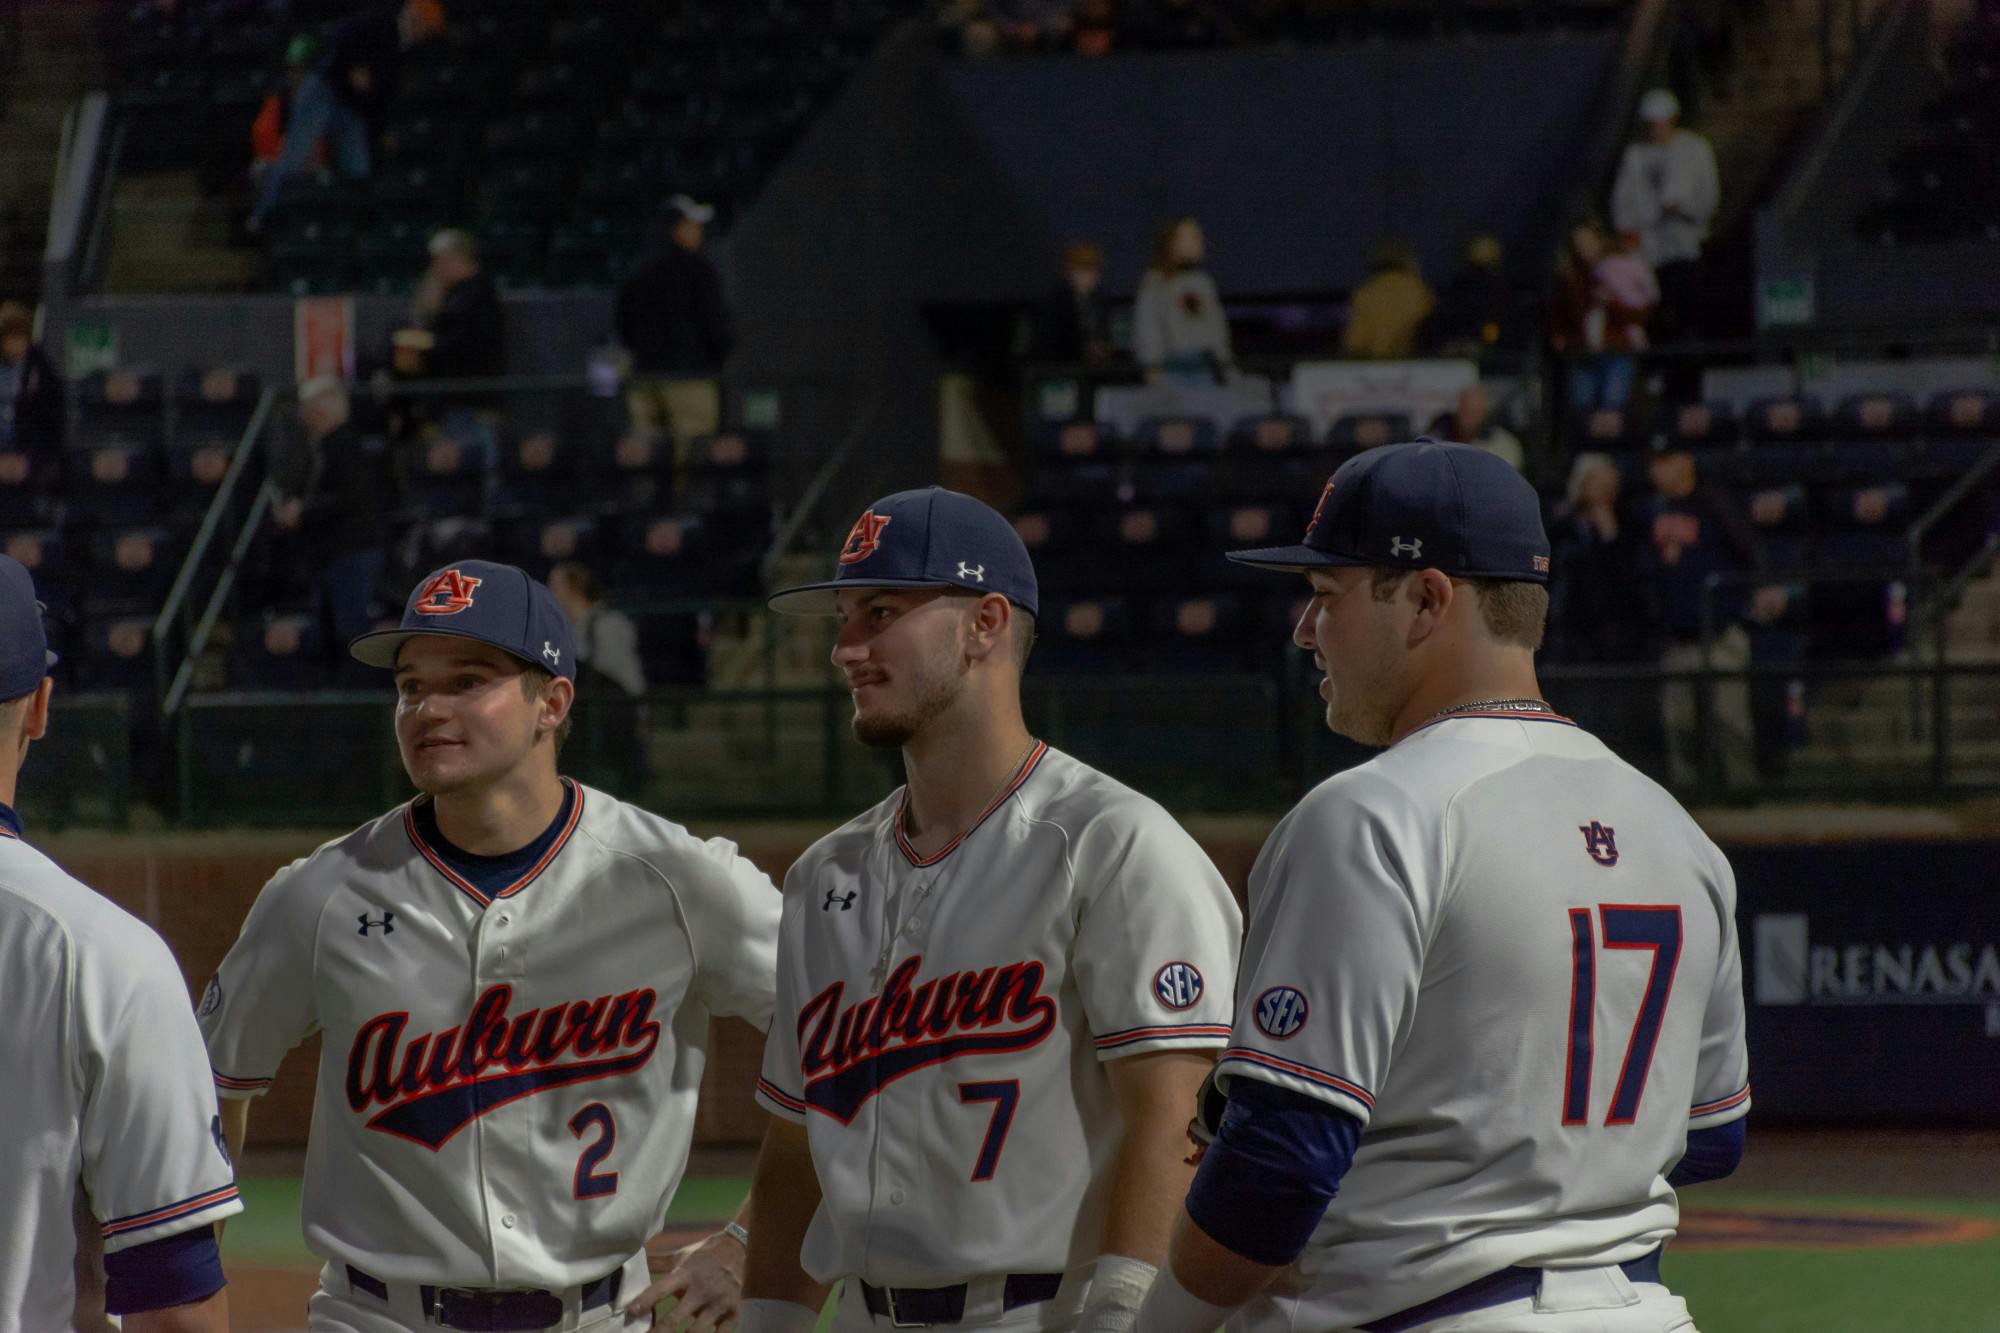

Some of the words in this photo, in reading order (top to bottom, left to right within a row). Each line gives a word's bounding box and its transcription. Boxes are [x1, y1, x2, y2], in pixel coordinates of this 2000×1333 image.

[798, 955, 1056, 1077] Auburn
[1158, 963, 1201, 1008] SEC
[1257, 988, 1305, 1037] SEC
[1562, 904, 1683, 1126] 17
[346, 984, 660, 1112] Auburn
[568, 1102, 618, 1200] 2
[958, 1079, 1020, 1182] 7
